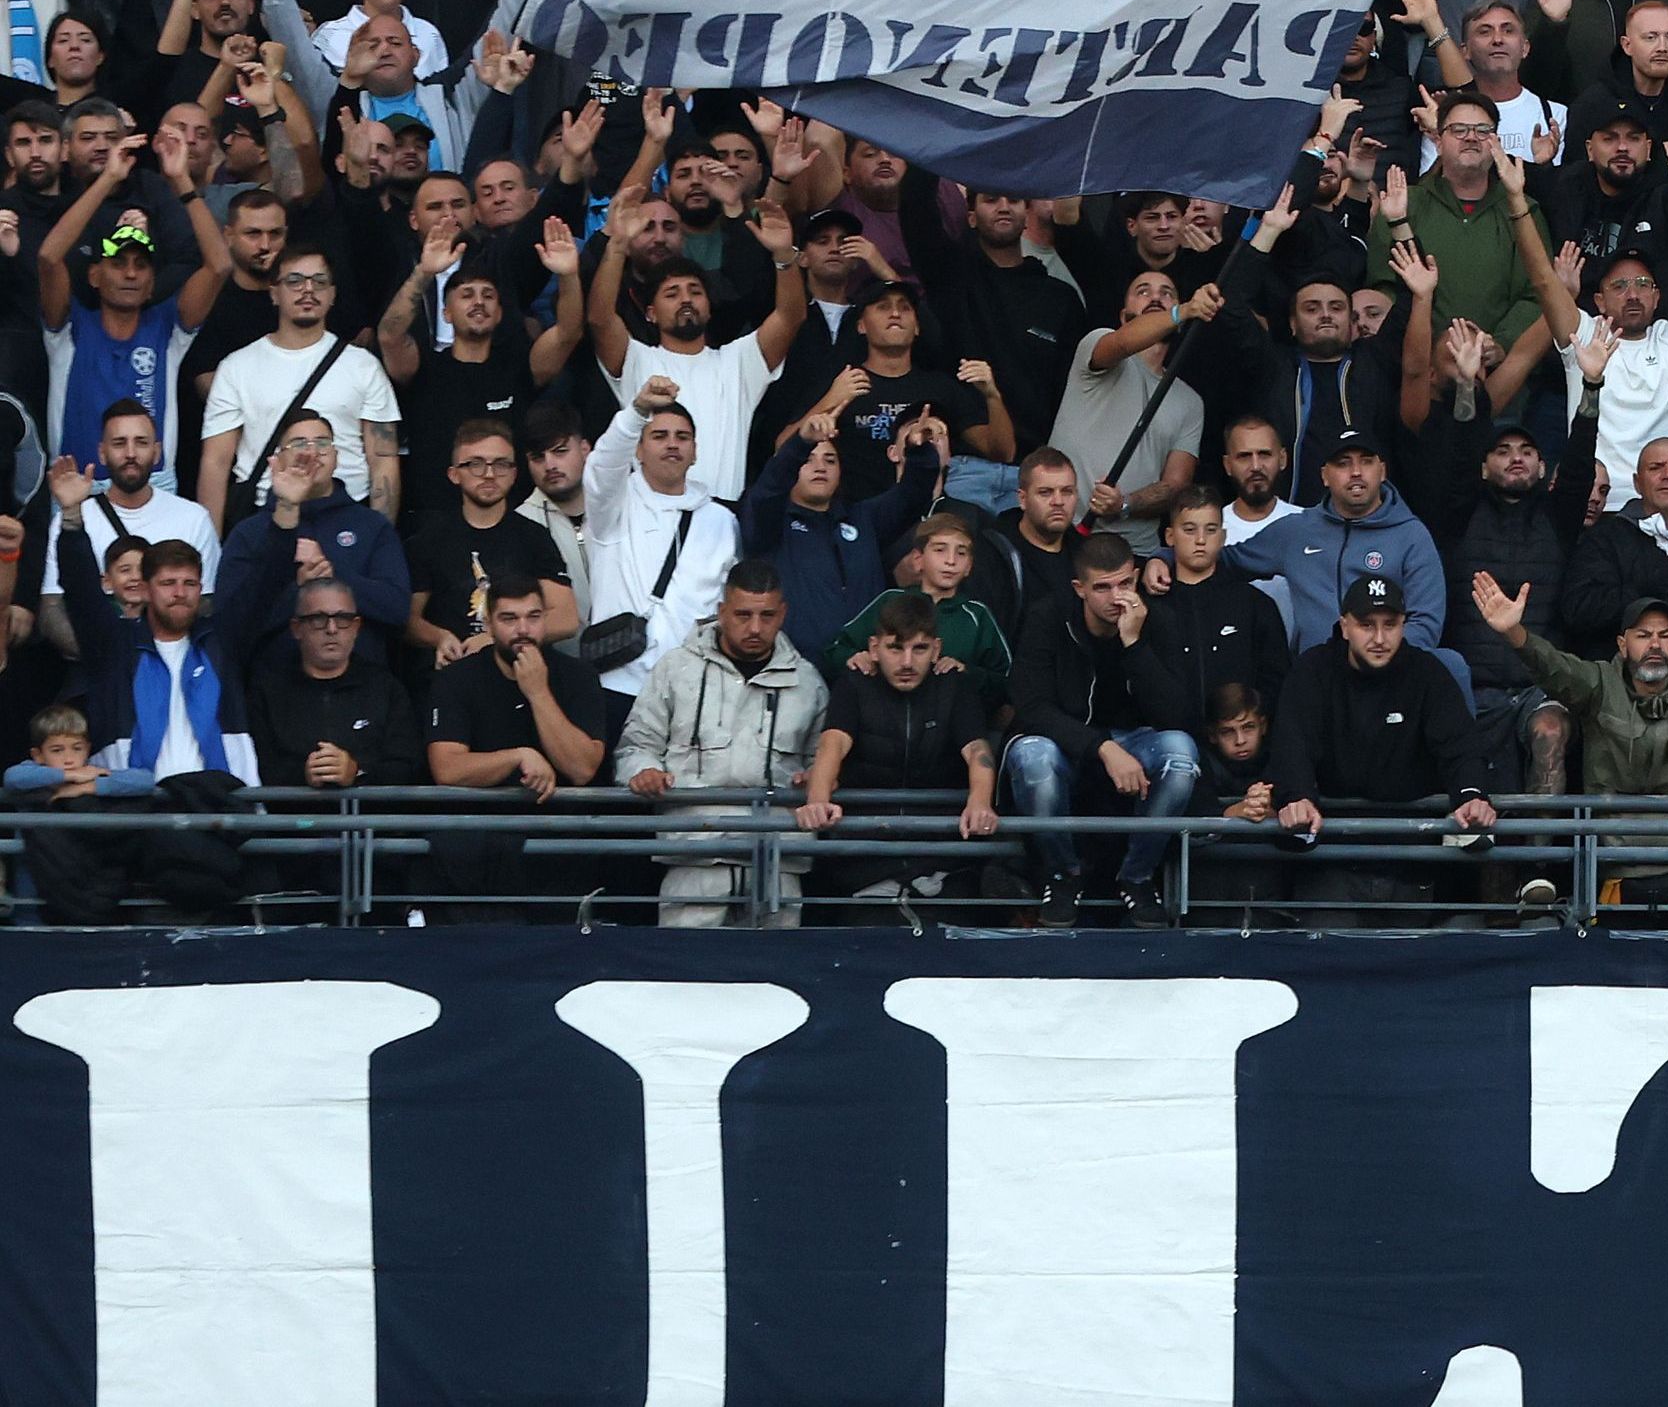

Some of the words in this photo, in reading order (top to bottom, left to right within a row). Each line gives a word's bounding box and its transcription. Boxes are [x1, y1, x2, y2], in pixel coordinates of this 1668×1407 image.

[855, 414, 898, 428] NORT
[871, 426, 890, 441] FA
[1368, 579, 1386, 596] NY
